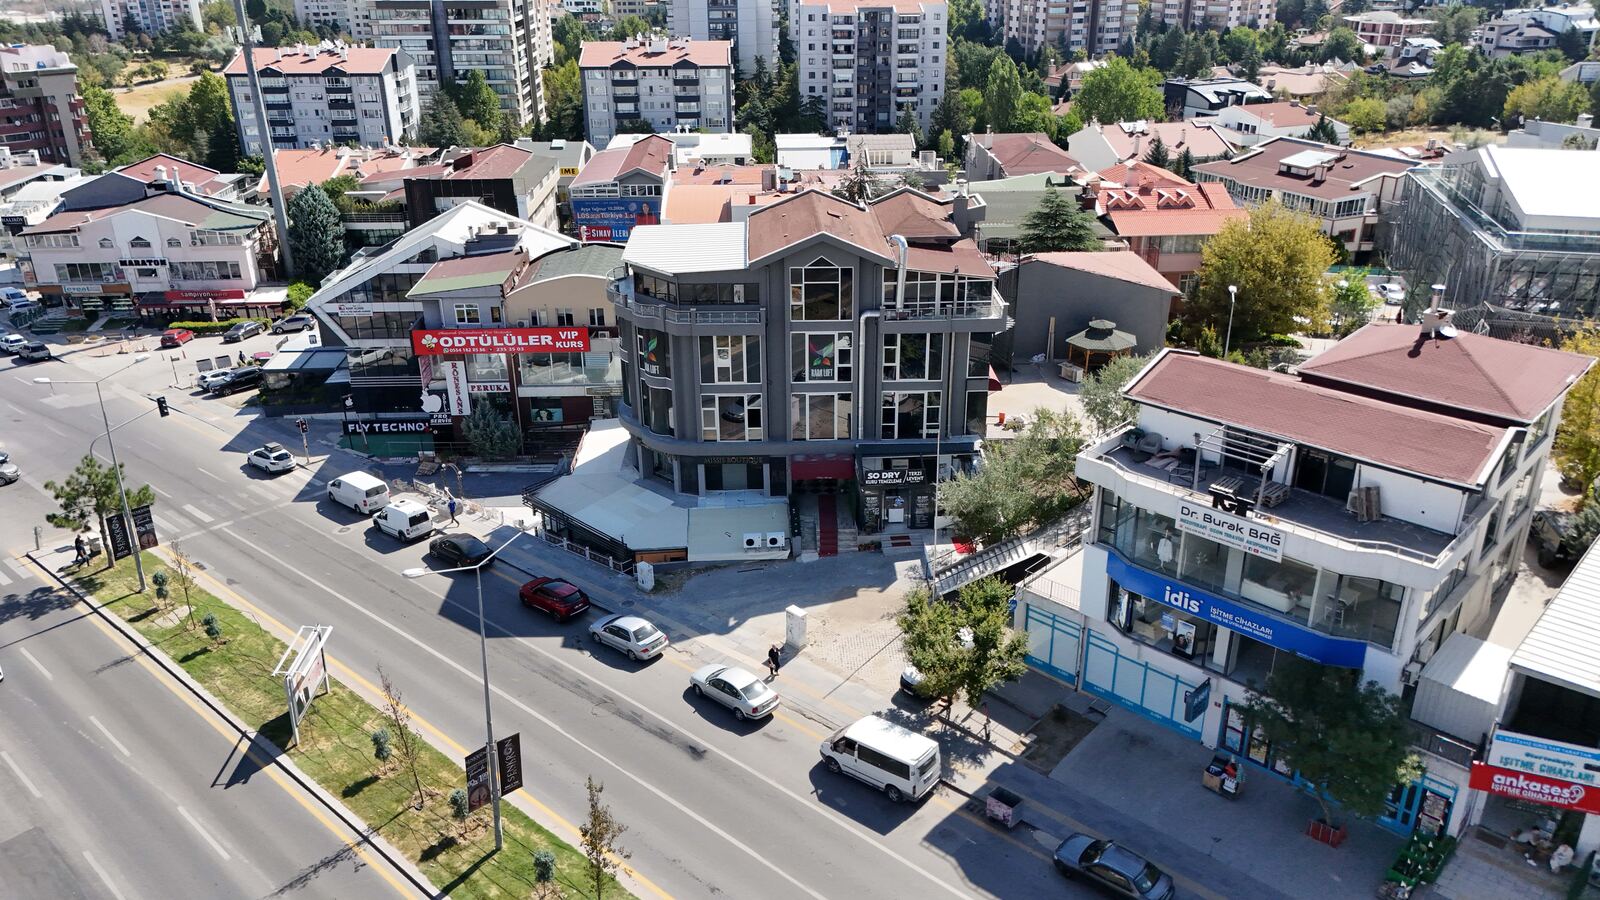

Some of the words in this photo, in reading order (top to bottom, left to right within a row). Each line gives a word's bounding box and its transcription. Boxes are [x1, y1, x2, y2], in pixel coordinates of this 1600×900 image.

[120, 259, 167, 267] MARATON
[439, 333, 553, 348] ODTÜLÜLER
[559, 331, 579, 340] VIP
[555, 341, 584, 349] KURS
[470, 384, 509, 392] PERUKA
[348, 423, 370, 433] FLY
[867, 472, 880, 480] SO
[882, 471, 901, 479] DRY
[1181, 506, 1198, 520] Dr.
[1203, 513, 1244, 535] Burak
[1249, 528, 1281, 546] BAĞ
[1164, 585, 1200, 613] idis
[1234, 615, 1273, 636] CİHAZLARI
[1493, 773, 1571, 799] ankases
